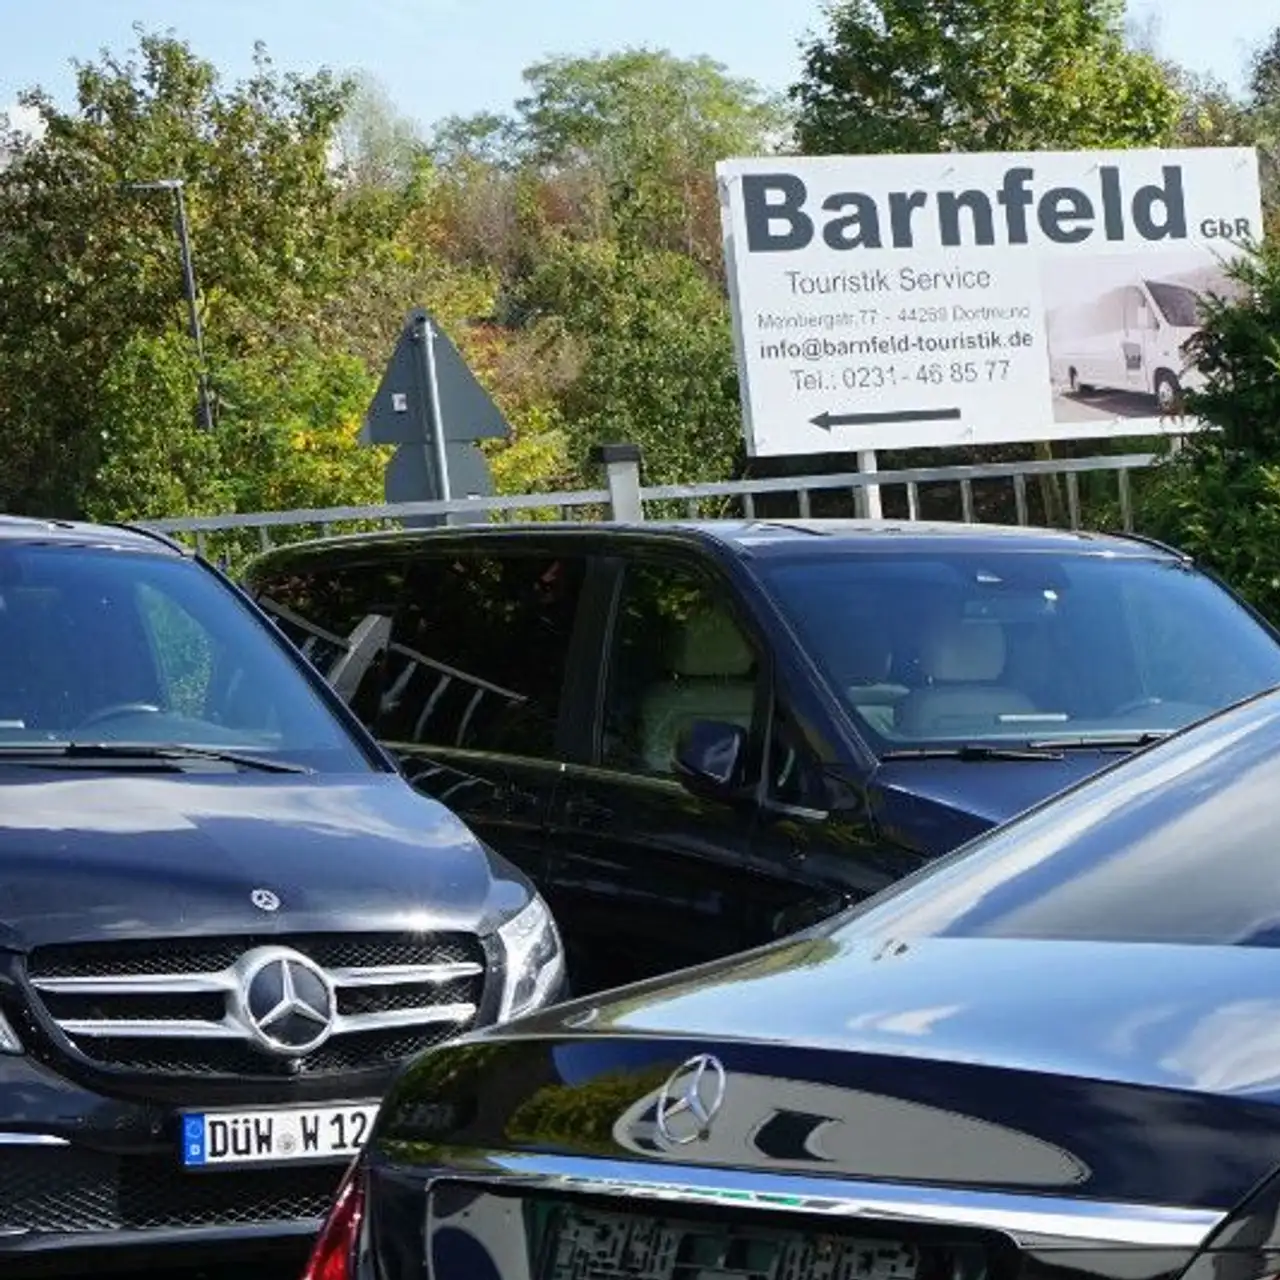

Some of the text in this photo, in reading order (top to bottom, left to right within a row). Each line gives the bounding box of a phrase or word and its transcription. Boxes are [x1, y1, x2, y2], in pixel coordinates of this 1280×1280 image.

[741, 165, 1251, 253] Barnfeld GbR
[784, 265, 991, 294] Touristik Service
[759, 331, 1034, 361] info@barnfeld-touristik.de
[842, 365, 897, 389] 0231
[916, 363, 943, 386] 46
[950, 361, 978, 383] 85
[984, 359, 1011, 382] 77
[208, 1117, 273, 1158] DÜW
[301, 1114, 319, 1152] W
